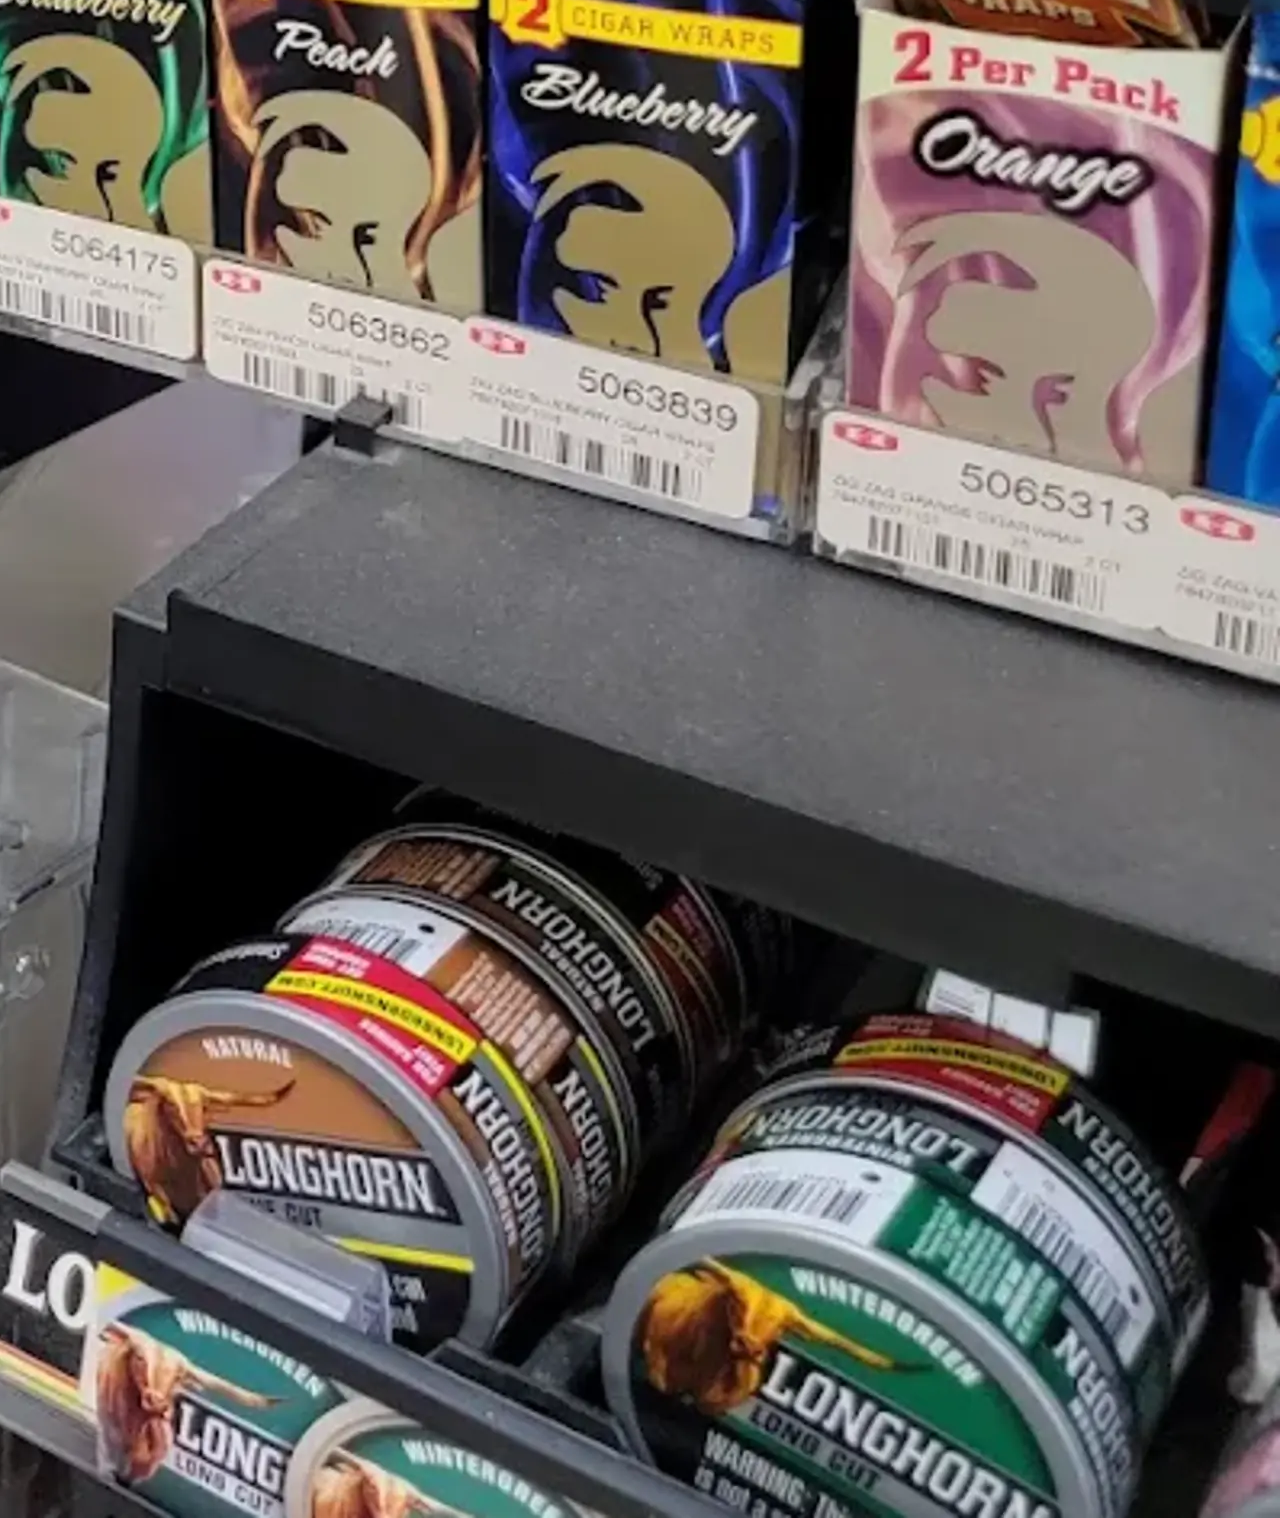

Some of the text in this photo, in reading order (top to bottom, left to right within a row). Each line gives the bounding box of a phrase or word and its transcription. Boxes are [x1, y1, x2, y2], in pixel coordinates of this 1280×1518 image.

[273, 20, 400, 79] Peach
[572, 9, 655, 42] CIGAR
[668, 22, 776, 55] WRAPS
[521, 62, 758, 157] Blueberry
[893, 31, 1181, 123] 2 Per Pack
[917, 114, 1143, 210] Orange
[50, 229, 181, 282] 5064175
[307, 300, 453, 363] 5063862
[577, 363, 739, 433] 5063839
[959, 460, 1153, 537] 5065313
[202, 1034, 294, 1072] NATURAL
[216, 1132, 439, 1219] LONGHORN
[174, 1307, 327, 1400] WINTERGREEN
[790, 1264, 985, 1389] WINTERGREEN
[747, 1404, 883, 1493] LONG CUT
